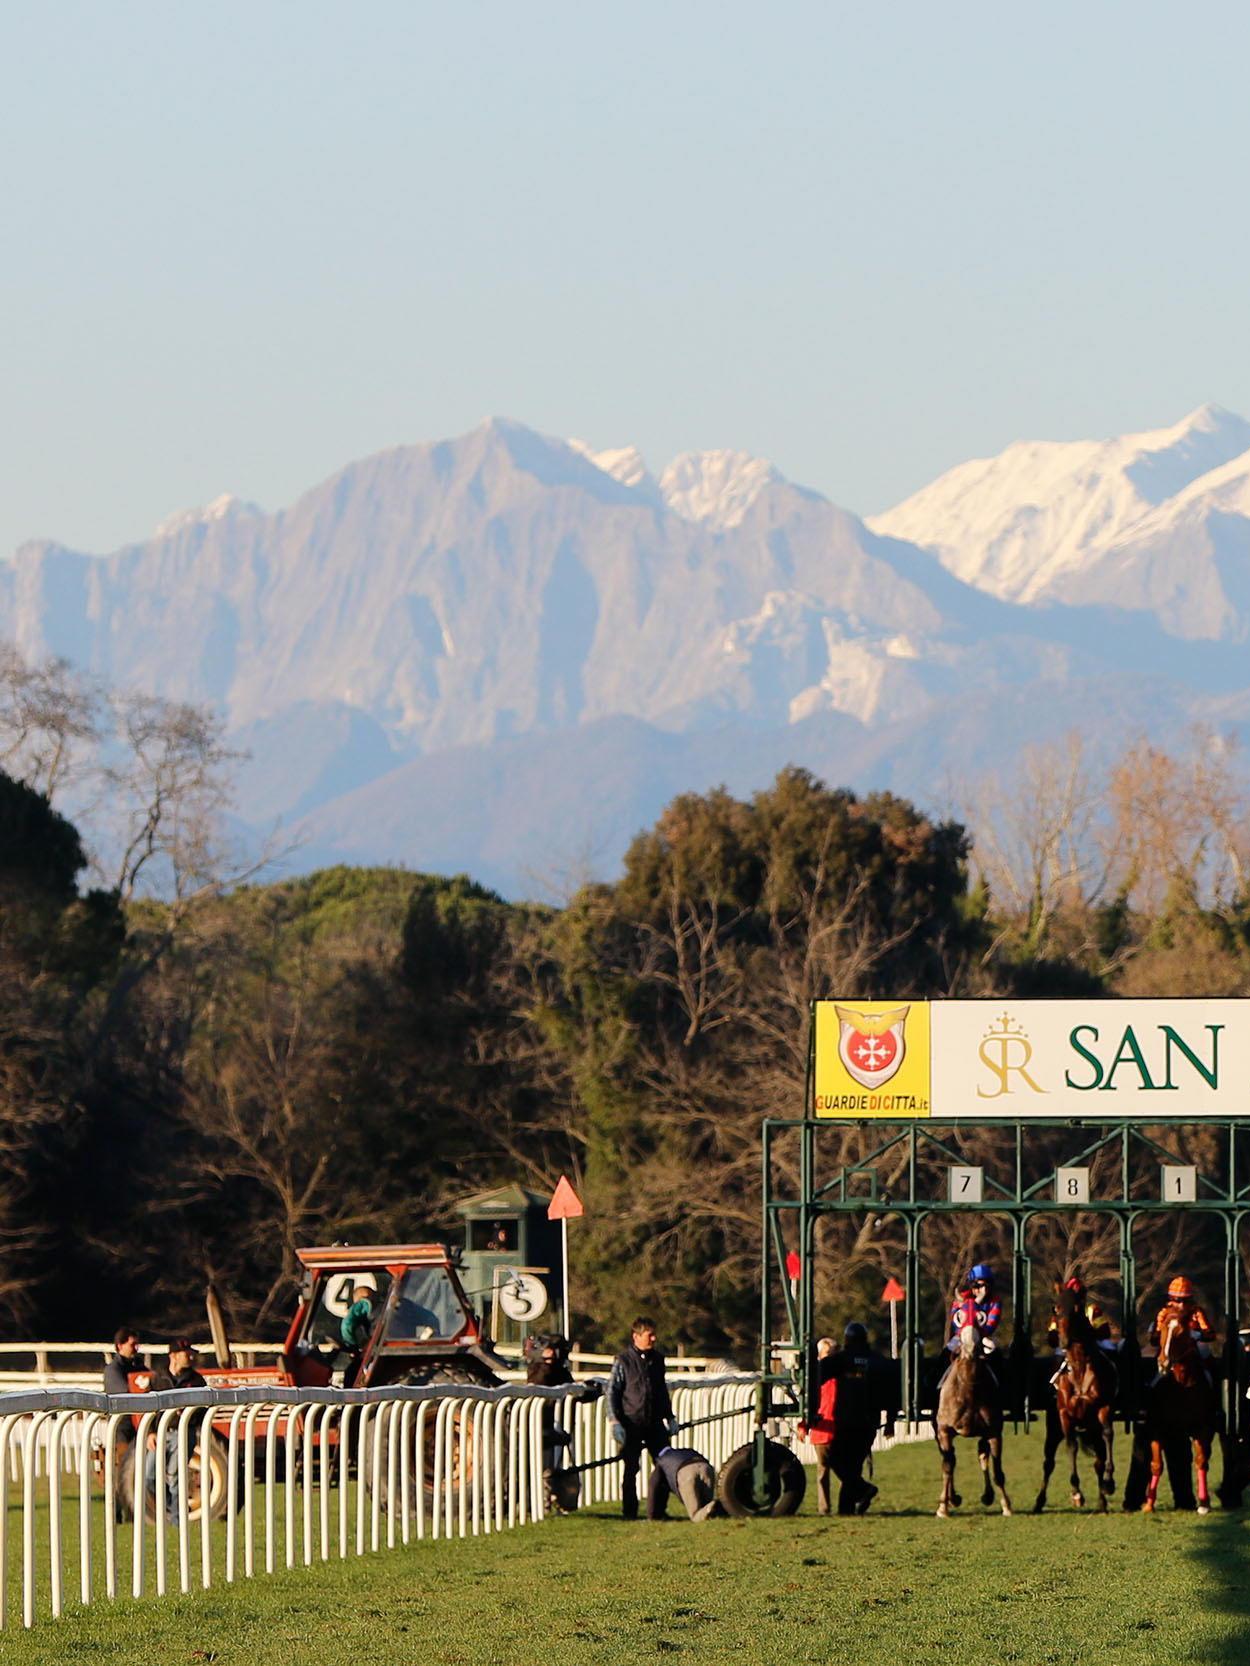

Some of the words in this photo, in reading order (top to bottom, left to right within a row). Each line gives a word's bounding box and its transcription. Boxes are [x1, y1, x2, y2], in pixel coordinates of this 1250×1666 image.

[1065, 1024, 1225, 1090] SAN
[961, 1175, 971, 1193] 7
[1068, 1179, 1078, 1196] 8
[1175, 1177, 1182, 1195] 1
